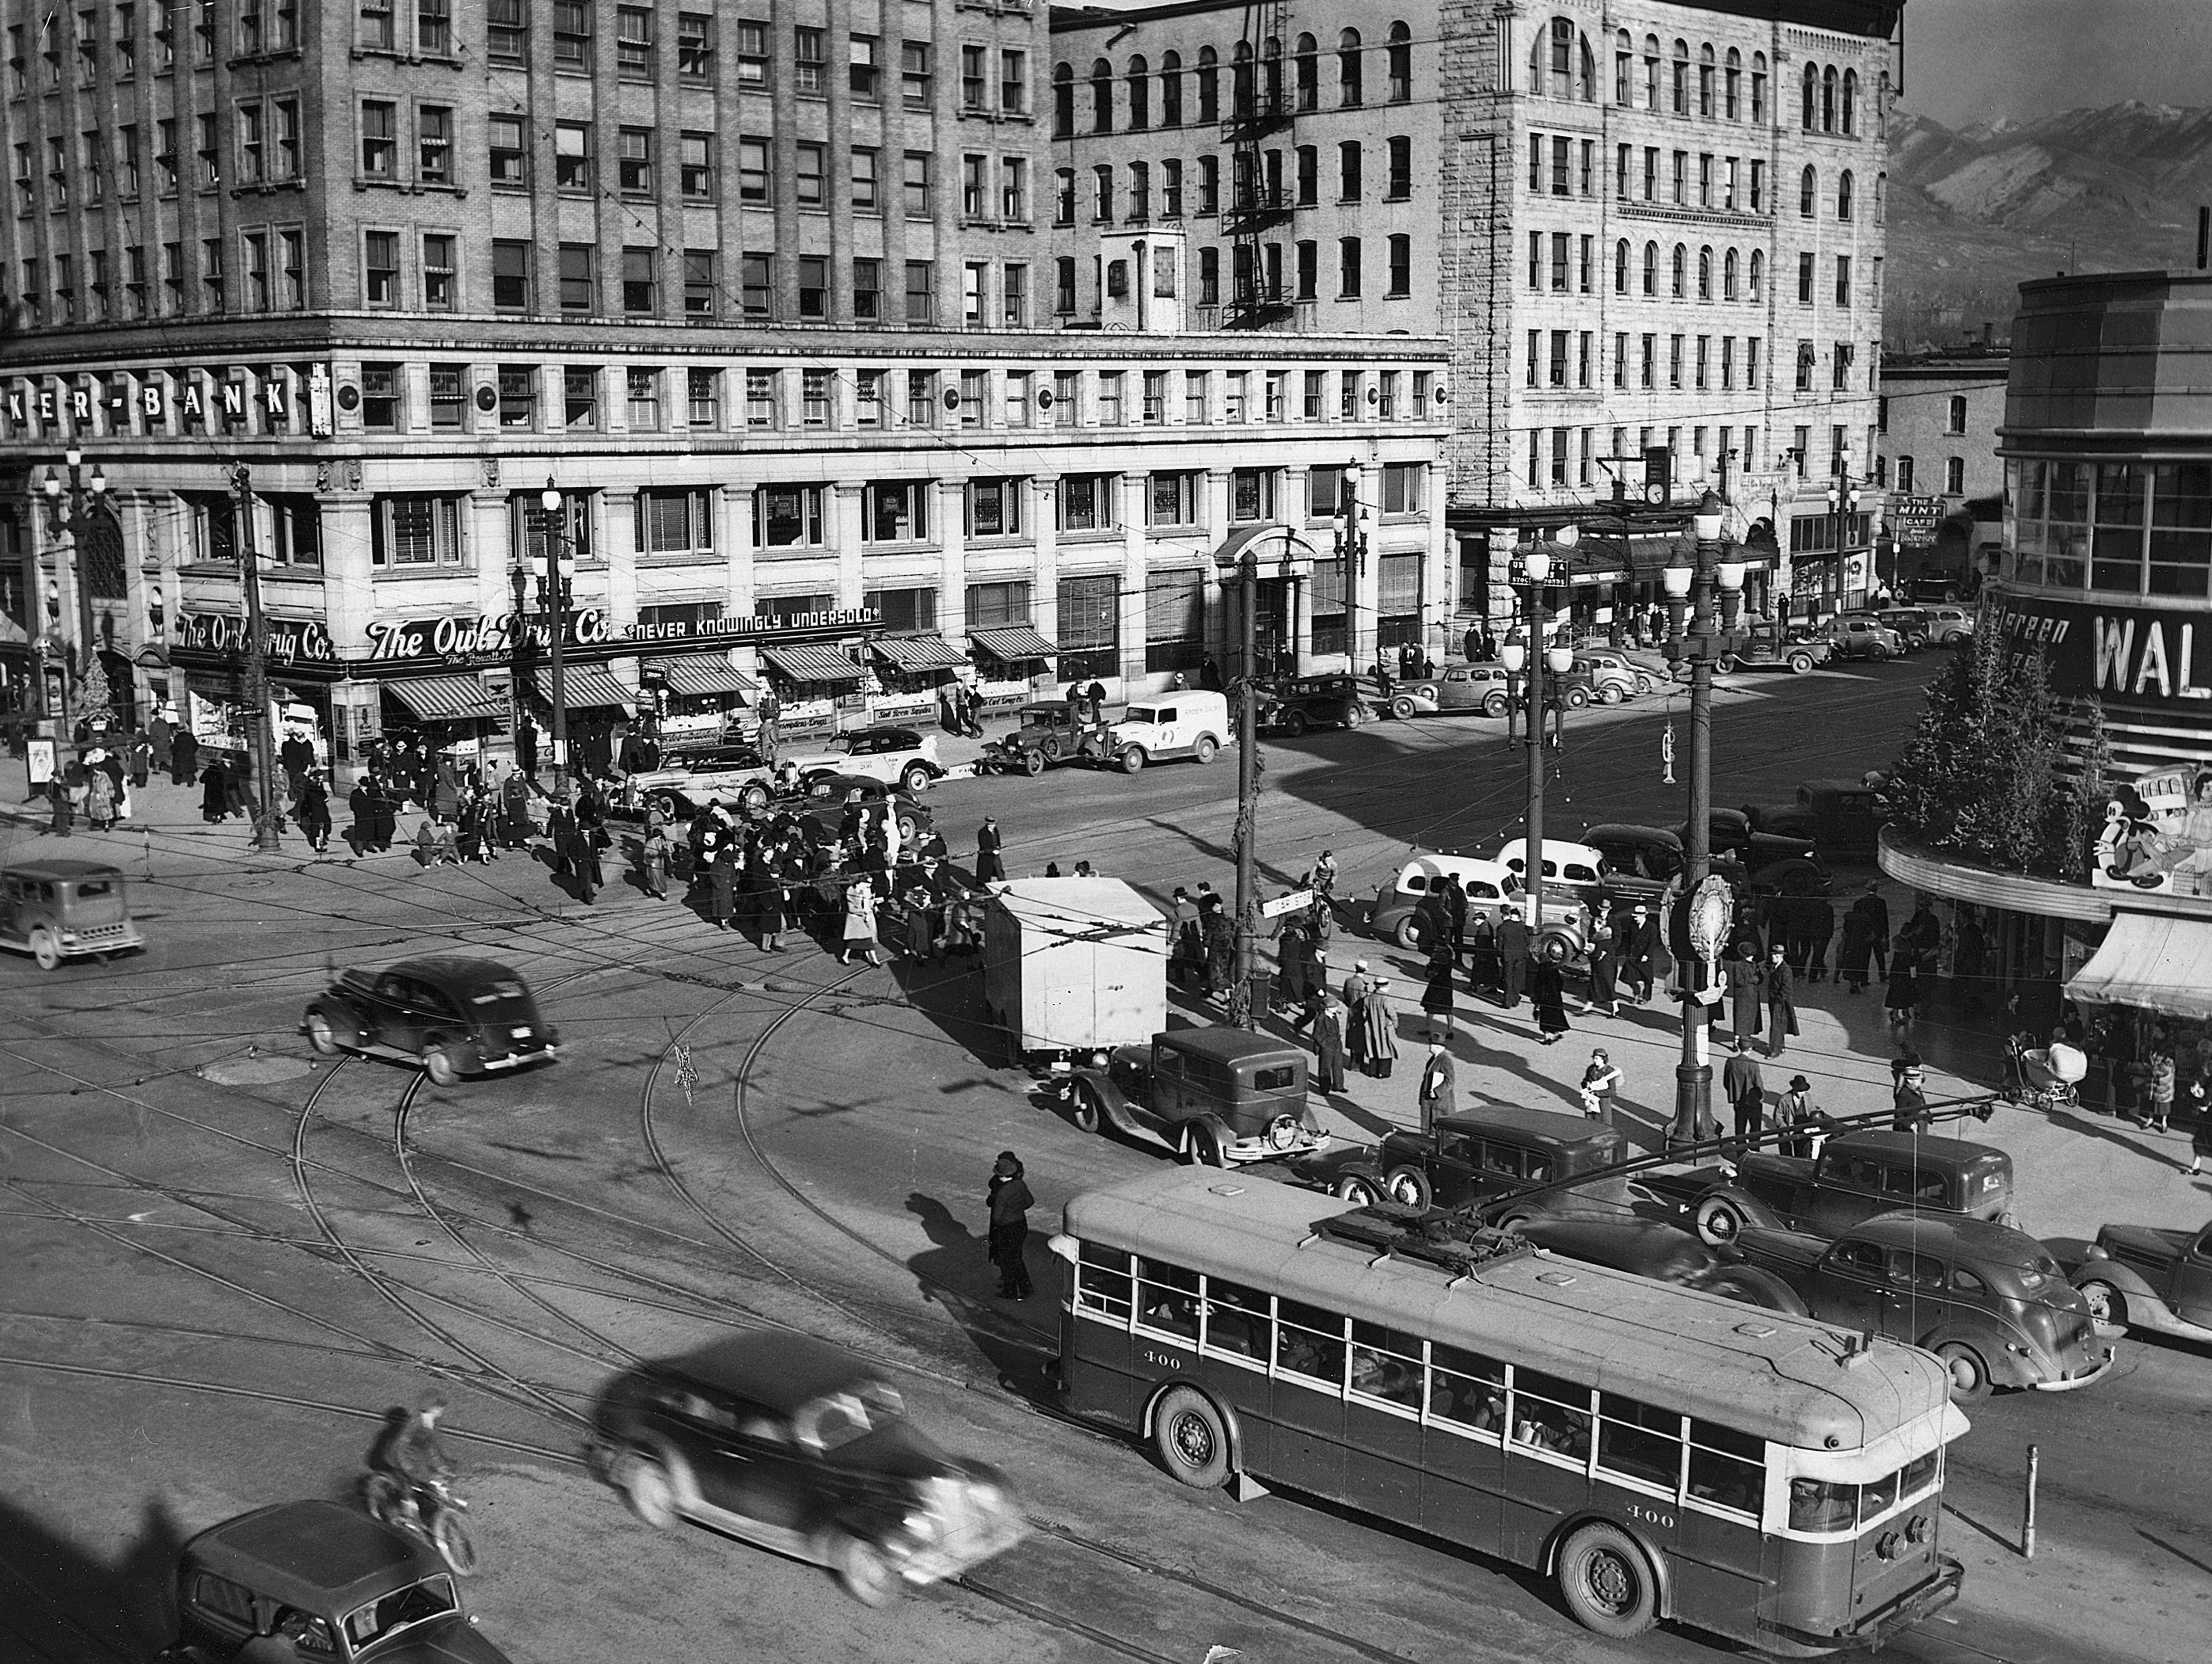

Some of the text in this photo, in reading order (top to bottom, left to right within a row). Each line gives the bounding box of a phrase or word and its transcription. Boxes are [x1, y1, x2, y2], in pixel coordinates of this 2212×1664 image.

[1899, 506, 1941, 515] MINT
[636, 607, 871, 639] NEVER KNOWINGLY UNDERSOLD
[175, 615, 207, 649] The
[263, 632, 297, 667] rug
[367, 620, 423, 660] The
[434, 617, 494, 654] Owl
[500, 613, 565, 656] Dru
[445, 655, 464, 665] The
[1275, 892, 1311, 912] CAR STOP
[1144, 1350, 1180, 1370] 400
[1627, 1505, 1674, 1528] 400
